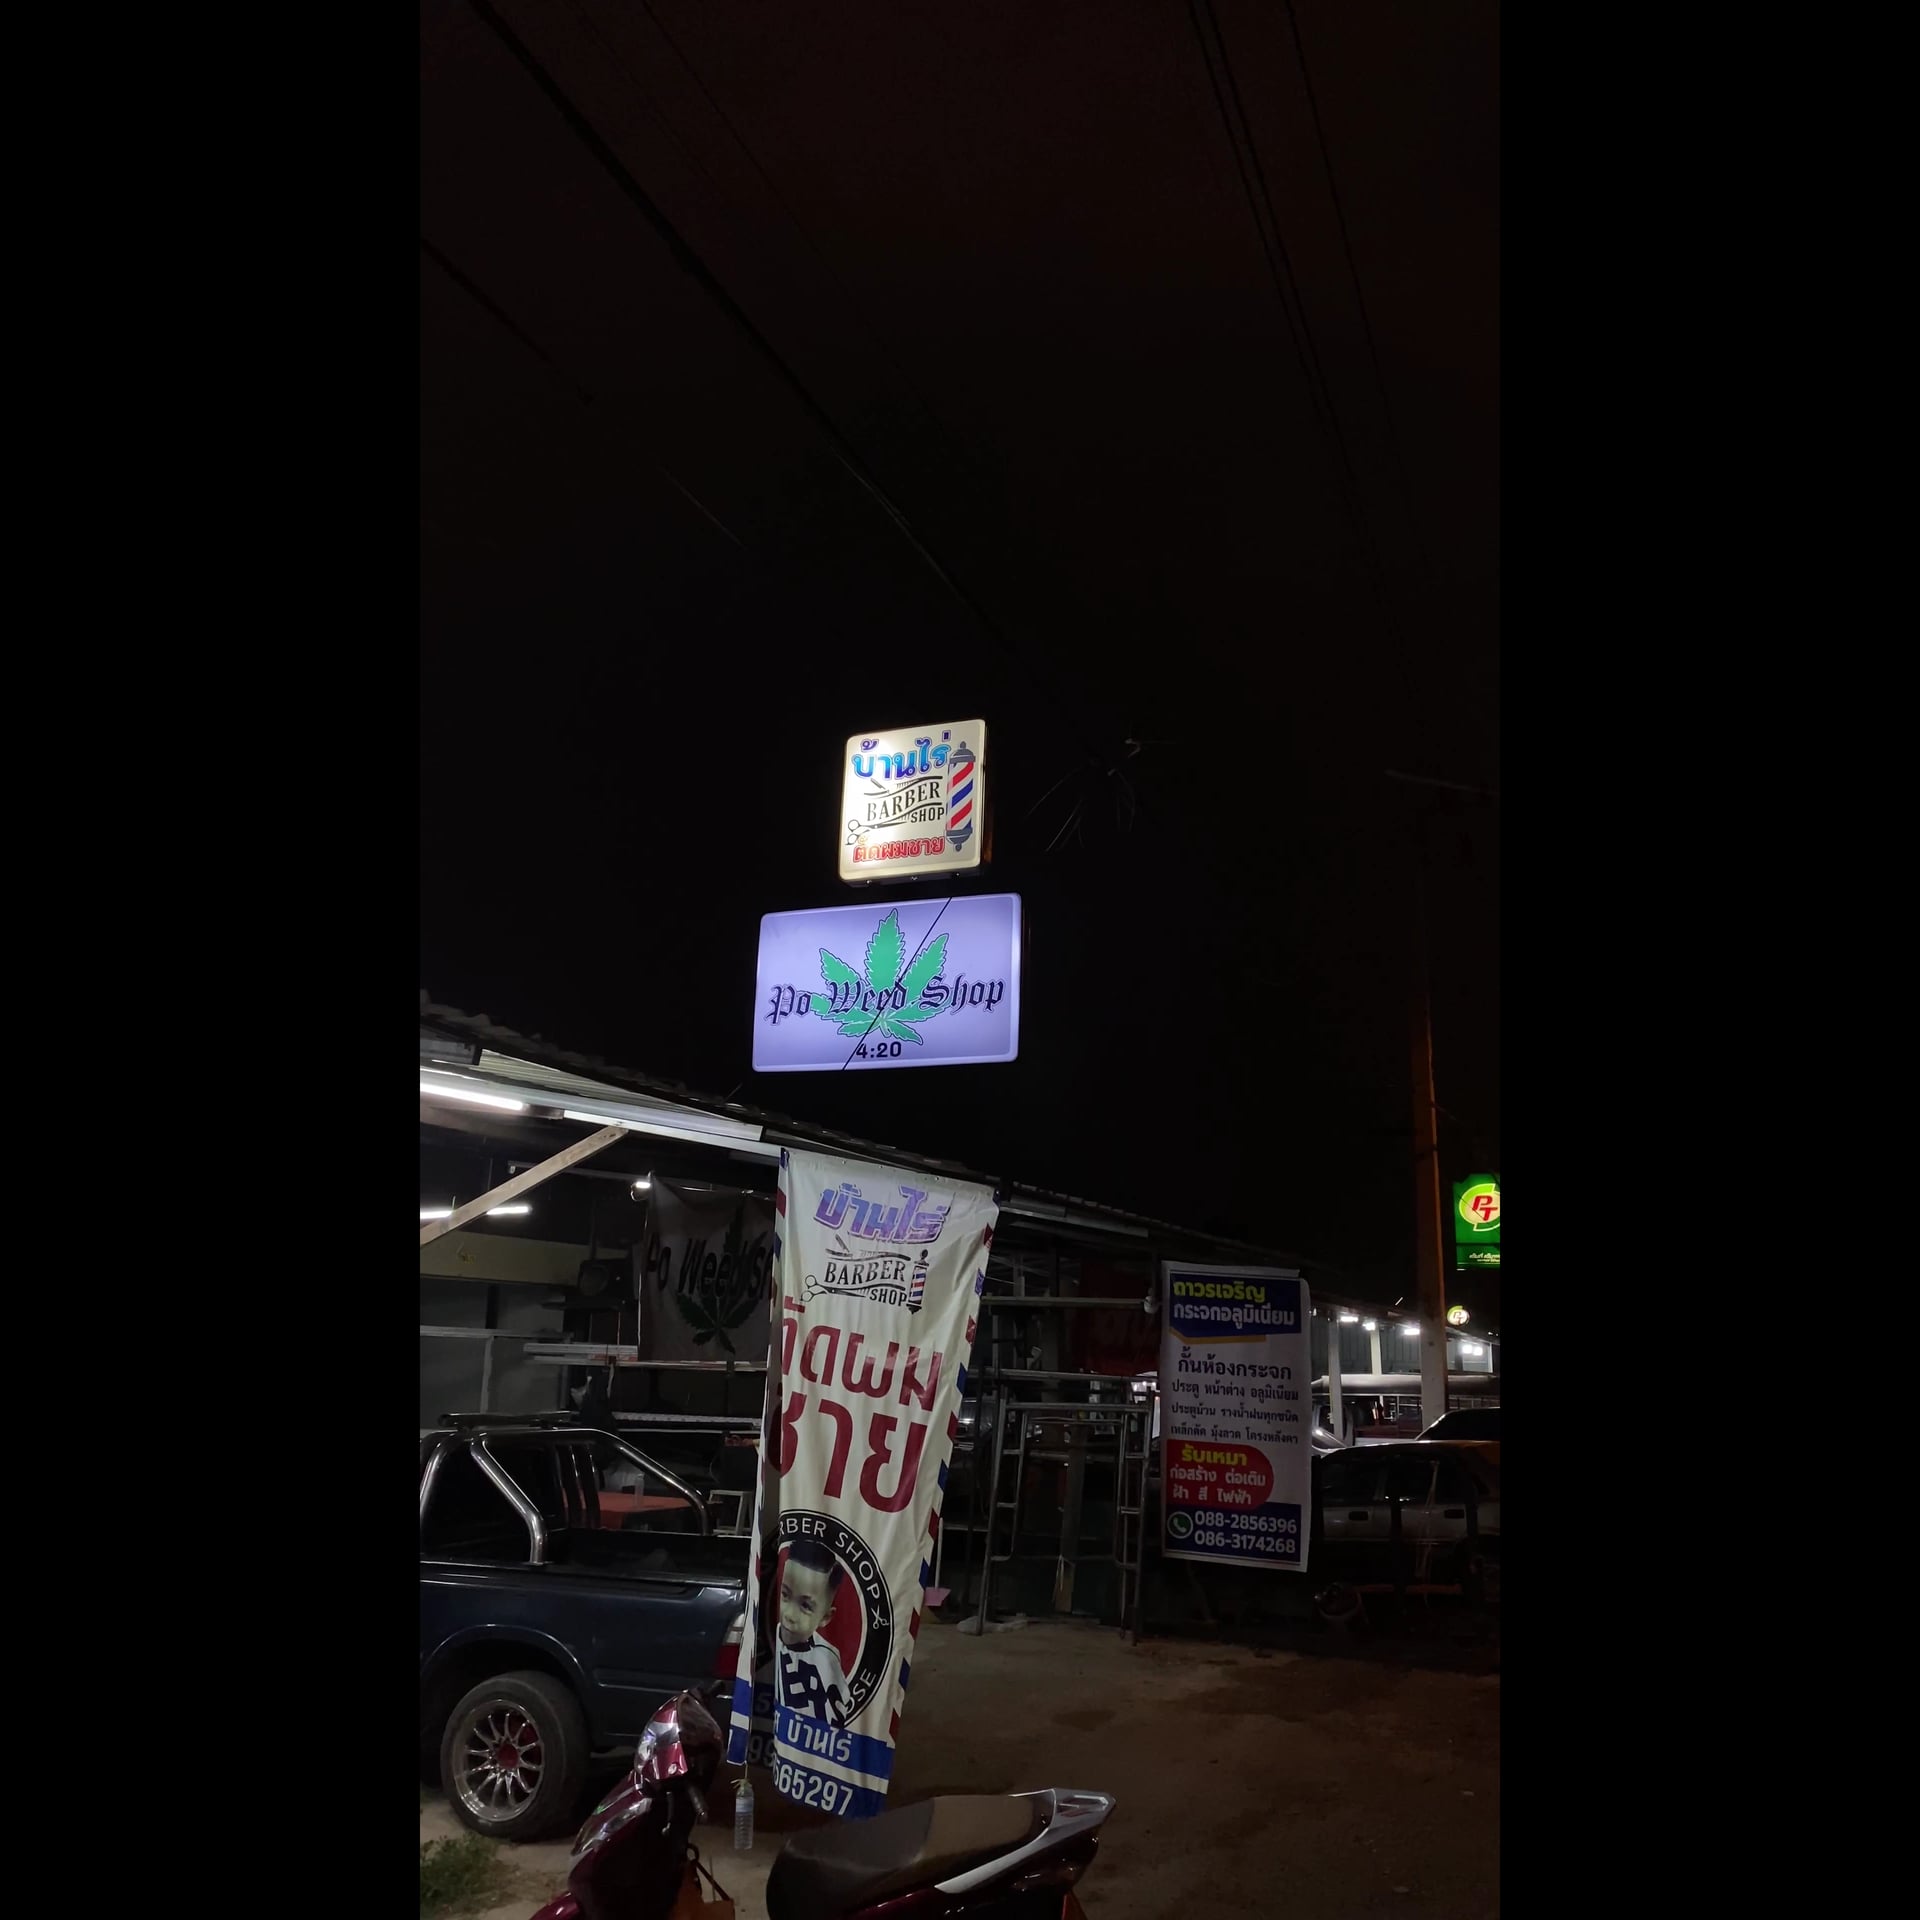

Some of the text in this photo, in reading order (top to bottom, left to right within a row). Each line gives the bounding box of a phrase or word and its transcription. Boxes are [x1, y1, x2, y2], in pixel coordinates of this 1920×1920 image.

[851, 730, 951, 780] บ้านไร่
[867, 781, 941, 821] BARBER
[910, 807, 944, 824] SHOP
[853, 836, 945, 863] ตัดผมชาย
[765, 976, 1004, 1024] Po Weed Shop
[856, 1041, 902, 1059] 4:20
[813, 1182, 950, 1244] บ้านไร่
[1472, 1195, 1498, 1222] PT
[824, 1259, 906, 1286] BARBER
[869, 1287, 908, 1306] SHOP
[1173, 1280, 1267, 1303] ถาวรเจริญ
[1173, 1302, 1295, 1329] กระจกอลูมิเนียม
[1178, 1346, 1292, 1380] กั้นห้องกระจก
[1171, 1379, 1299, 1404] ประตู หน้าต่าง อลูมิเนียม
[1170, 1402, 1299, 1424] ประตูม้วน รางน้ำฝนทุกชนิด
[1246, 1427, 1299, 1444] โครงหลังคา
[1181, 1445, 1249, 1467] รับเหมา
[1169, 1465, 1267, 1487] ก่อสร้าง ต่อเติม
[1172, 1484, 1252, 1505] ฝ้า สี ไฟฟ้า
[1195, 1510, 1297, 1535] 088-2856396
[1194, 1530, 1296, 1553] 086-3174268
[835, 1532, 881, 1600] SHOP
[787, 1714, 853, 1763] บ้านไร่
